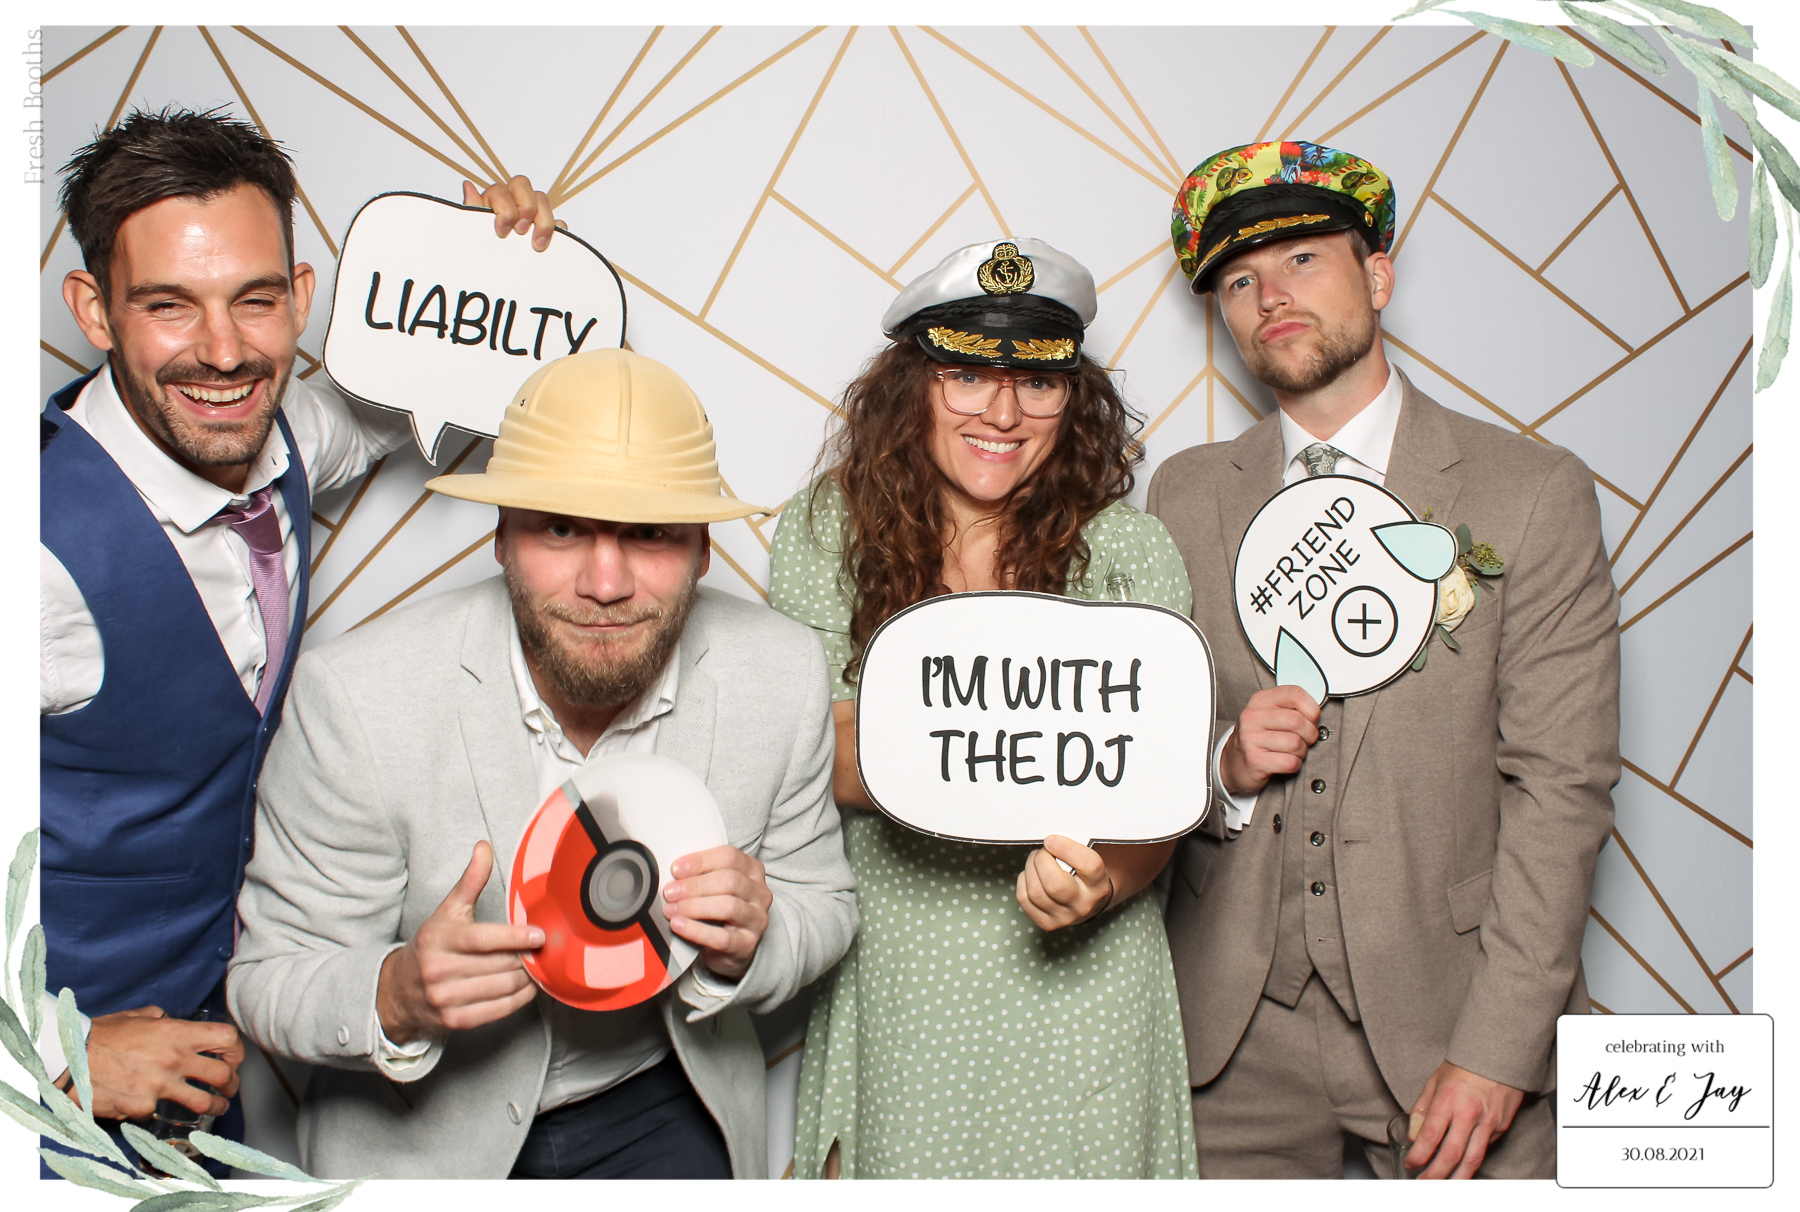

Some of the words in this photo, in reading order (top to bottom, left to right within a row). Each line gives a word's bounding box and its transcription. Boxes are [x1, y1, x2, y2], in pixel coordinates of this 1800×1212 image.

[365, 271, 598, 361] LIABILTY
[1250, 496, 1356, 614] #FRIEND
[1287, 538, 1361, 620] ZONE
[921, 655, 989, 711] I'M
[1001, 656, 1142, 713] WITH
[929, 729, 1045, 785] THE
[1056, 731, 1133, 787] DJ
